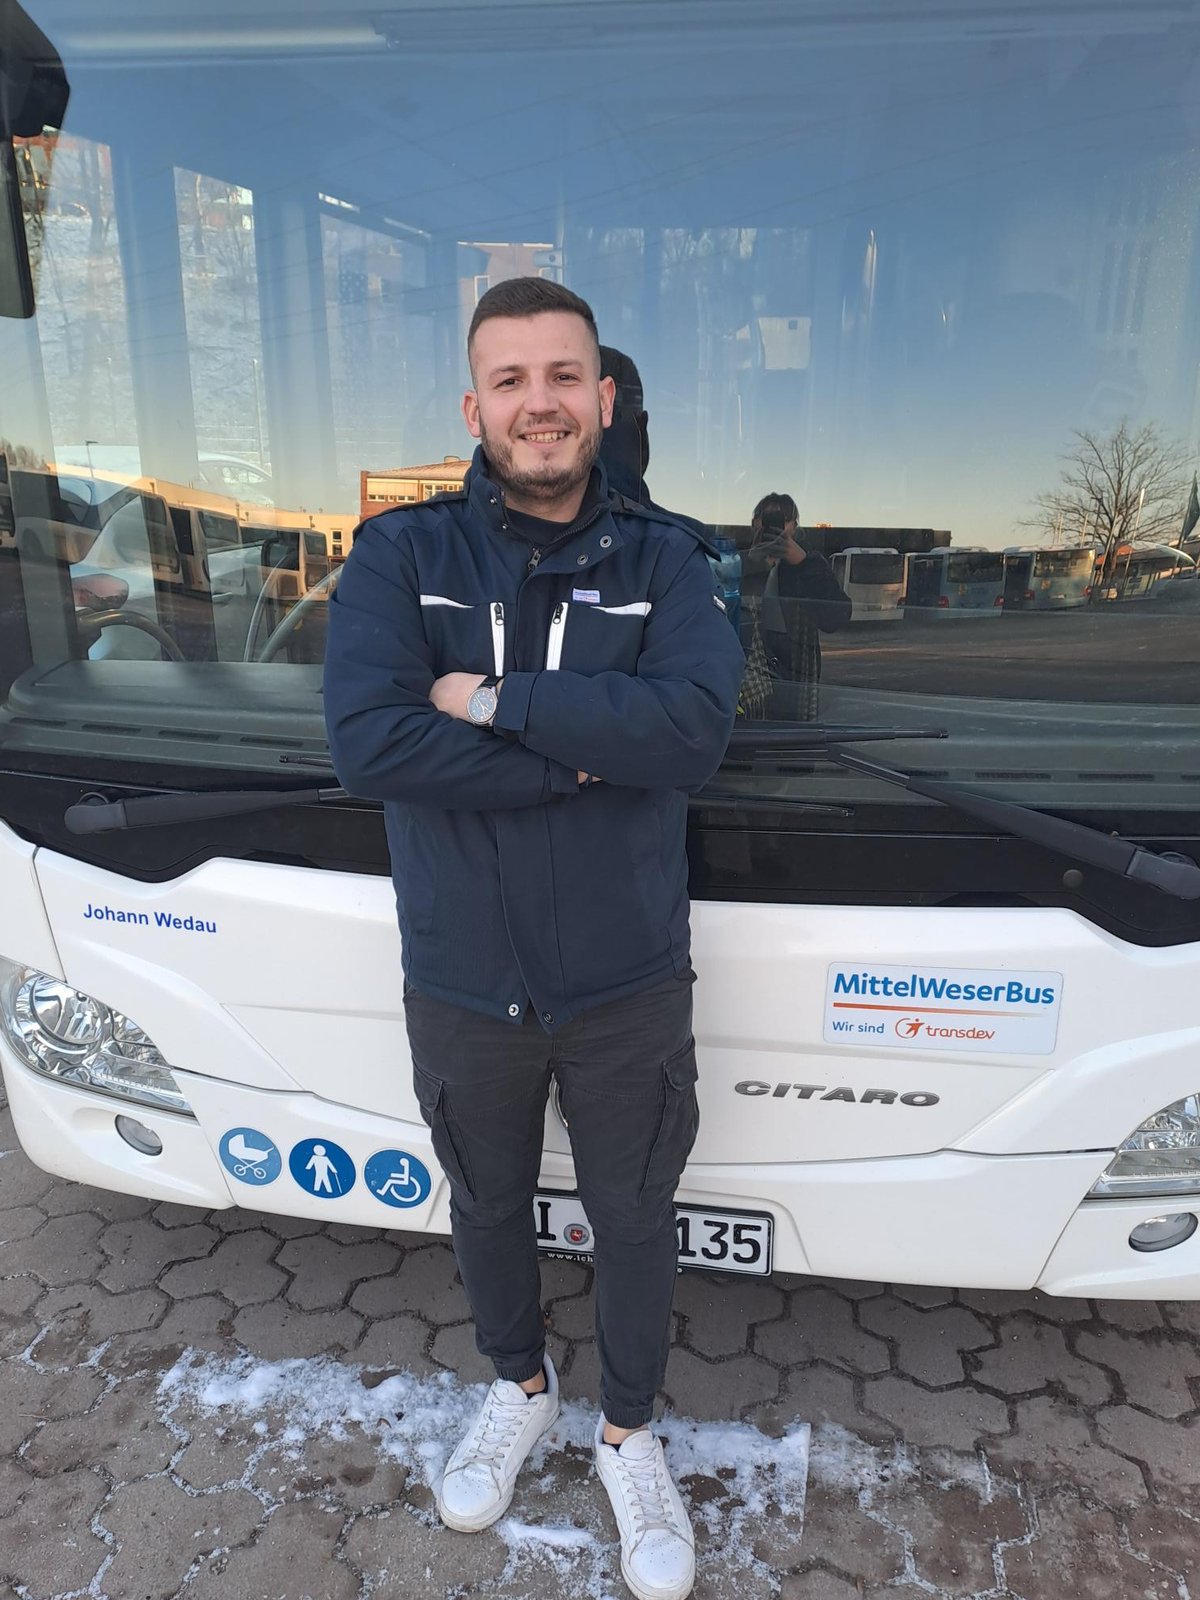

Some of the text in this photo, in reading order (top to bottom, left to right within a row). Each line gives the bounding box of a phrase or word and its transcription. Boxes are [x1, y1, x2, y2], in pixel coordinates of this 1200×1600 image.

[83, 903, 217, 933] Johann Wedau
[833, 972, 1055, 1004] MittelWeserBus
[832, 1021, 885, 1034] Wir sind
[925, 1024, 996, 1040] transdev
[734, 1080, 940, 1107] CITARO
[676, 1217, 762, 1264] 135
